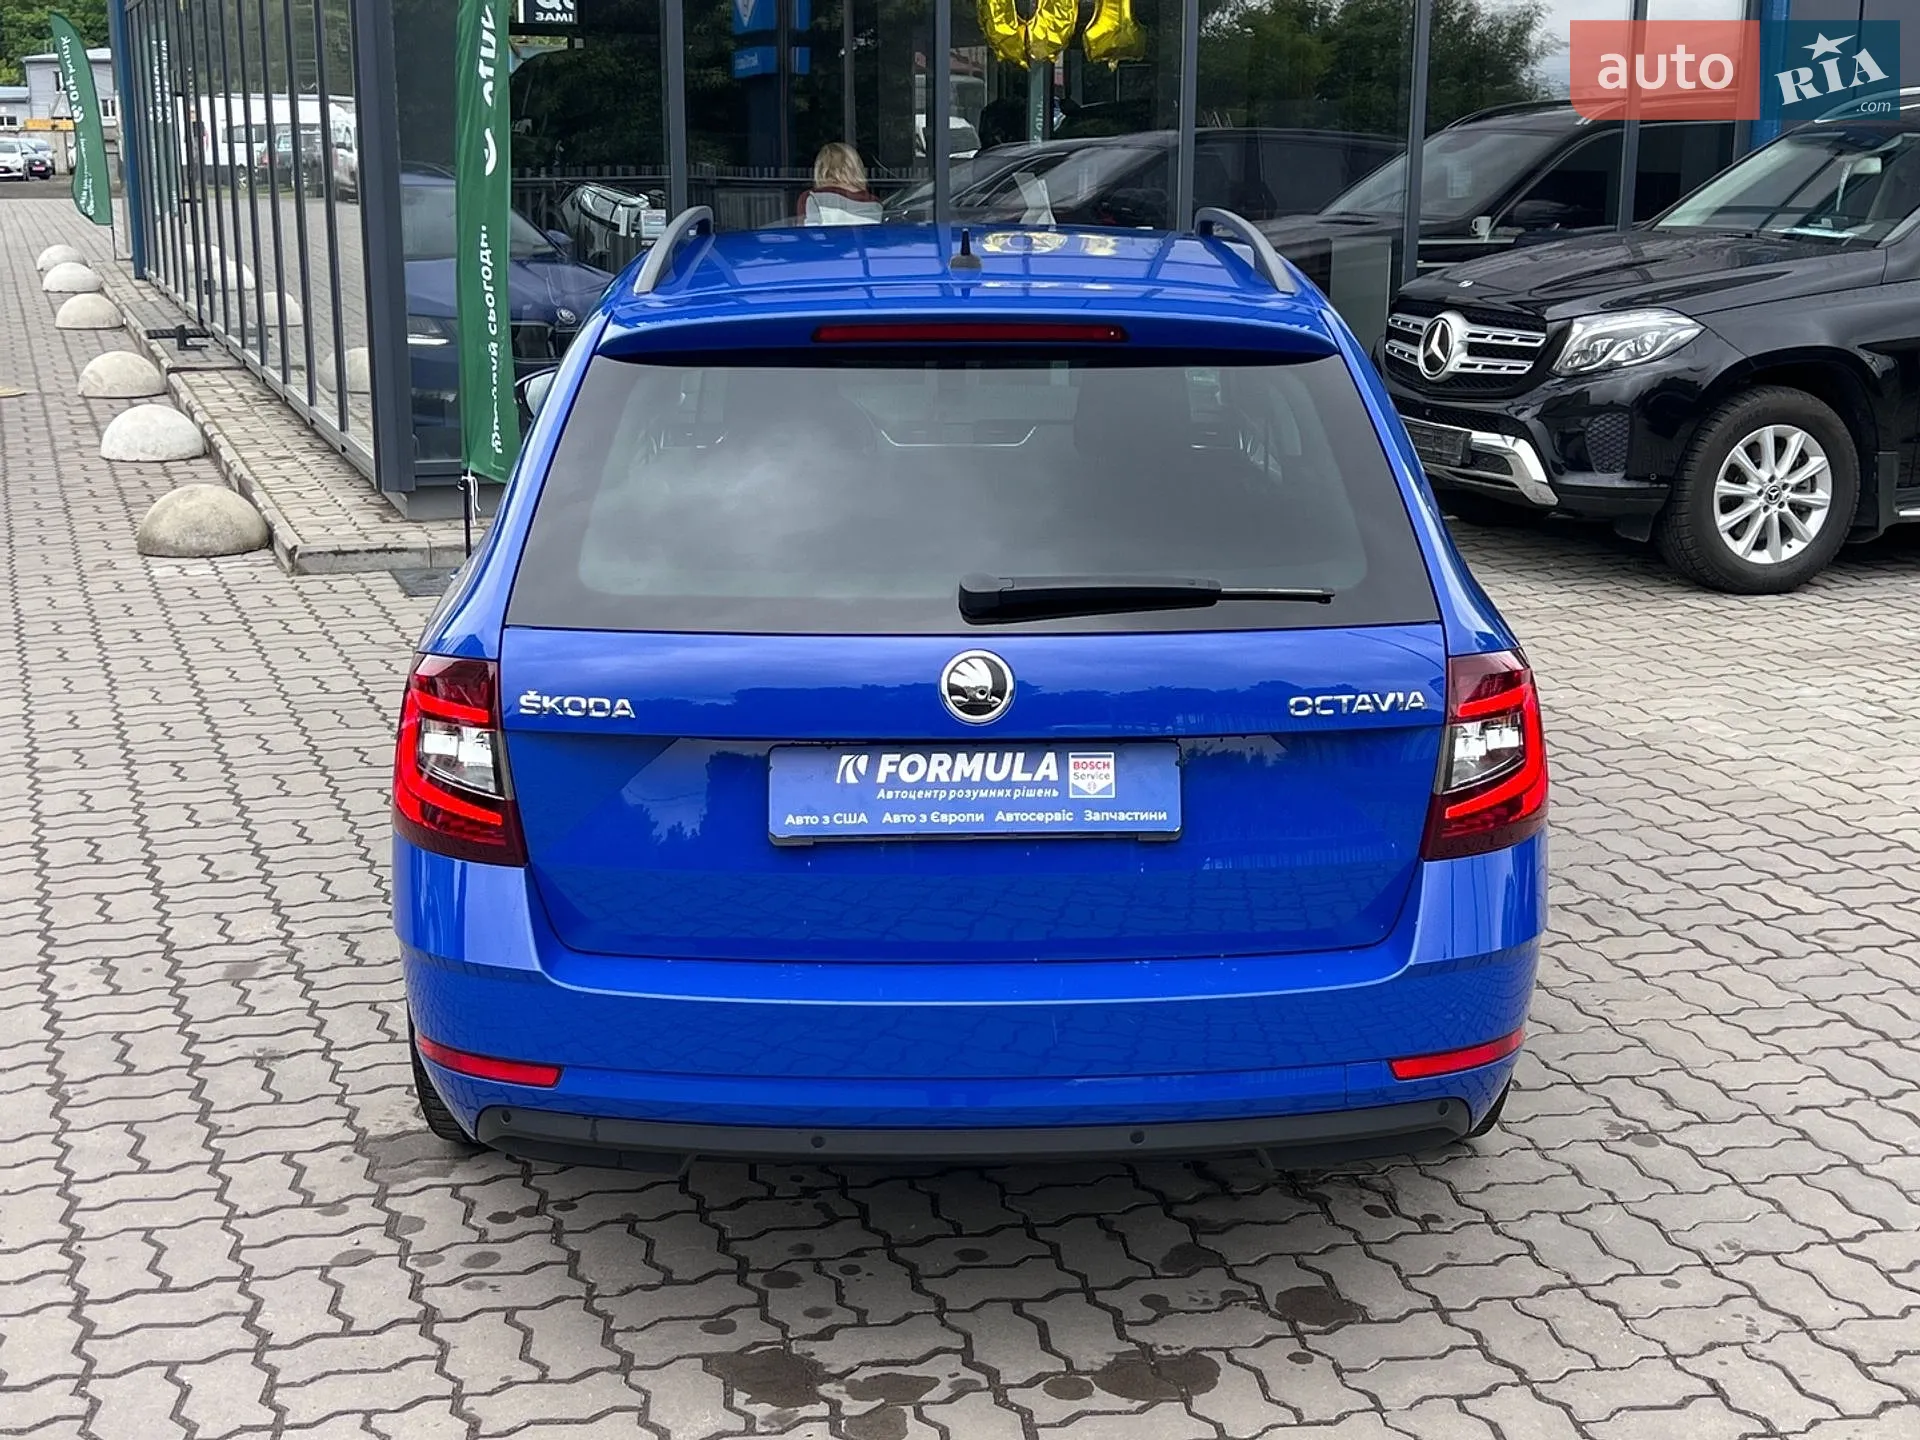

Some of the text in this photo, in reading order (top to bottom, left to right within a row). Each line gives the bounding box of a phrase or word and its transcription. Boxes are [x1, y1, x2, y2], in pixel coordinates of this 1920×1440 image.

[519, 690, 636, 719] ŠKODA
[1288, 691, 1428, 717] OCTAVIA
[876, 752, 1059, 784] FORMULA
[1073, 761, 1110, 770] BOSCH
[1073, 772, 1111, 781] Service
[876, 786, 1059, 801] Автоцентр розумних рішень
[785, 814, 819, 826] Авто
[833, 812, 869, 825] США
[882, 811, 916, 824] Авто
[930, 811, 985, 826] Європи
[994, 809, 1074, 824] Автосервіс
[1084, 809, 1168, 822] Запчастини
